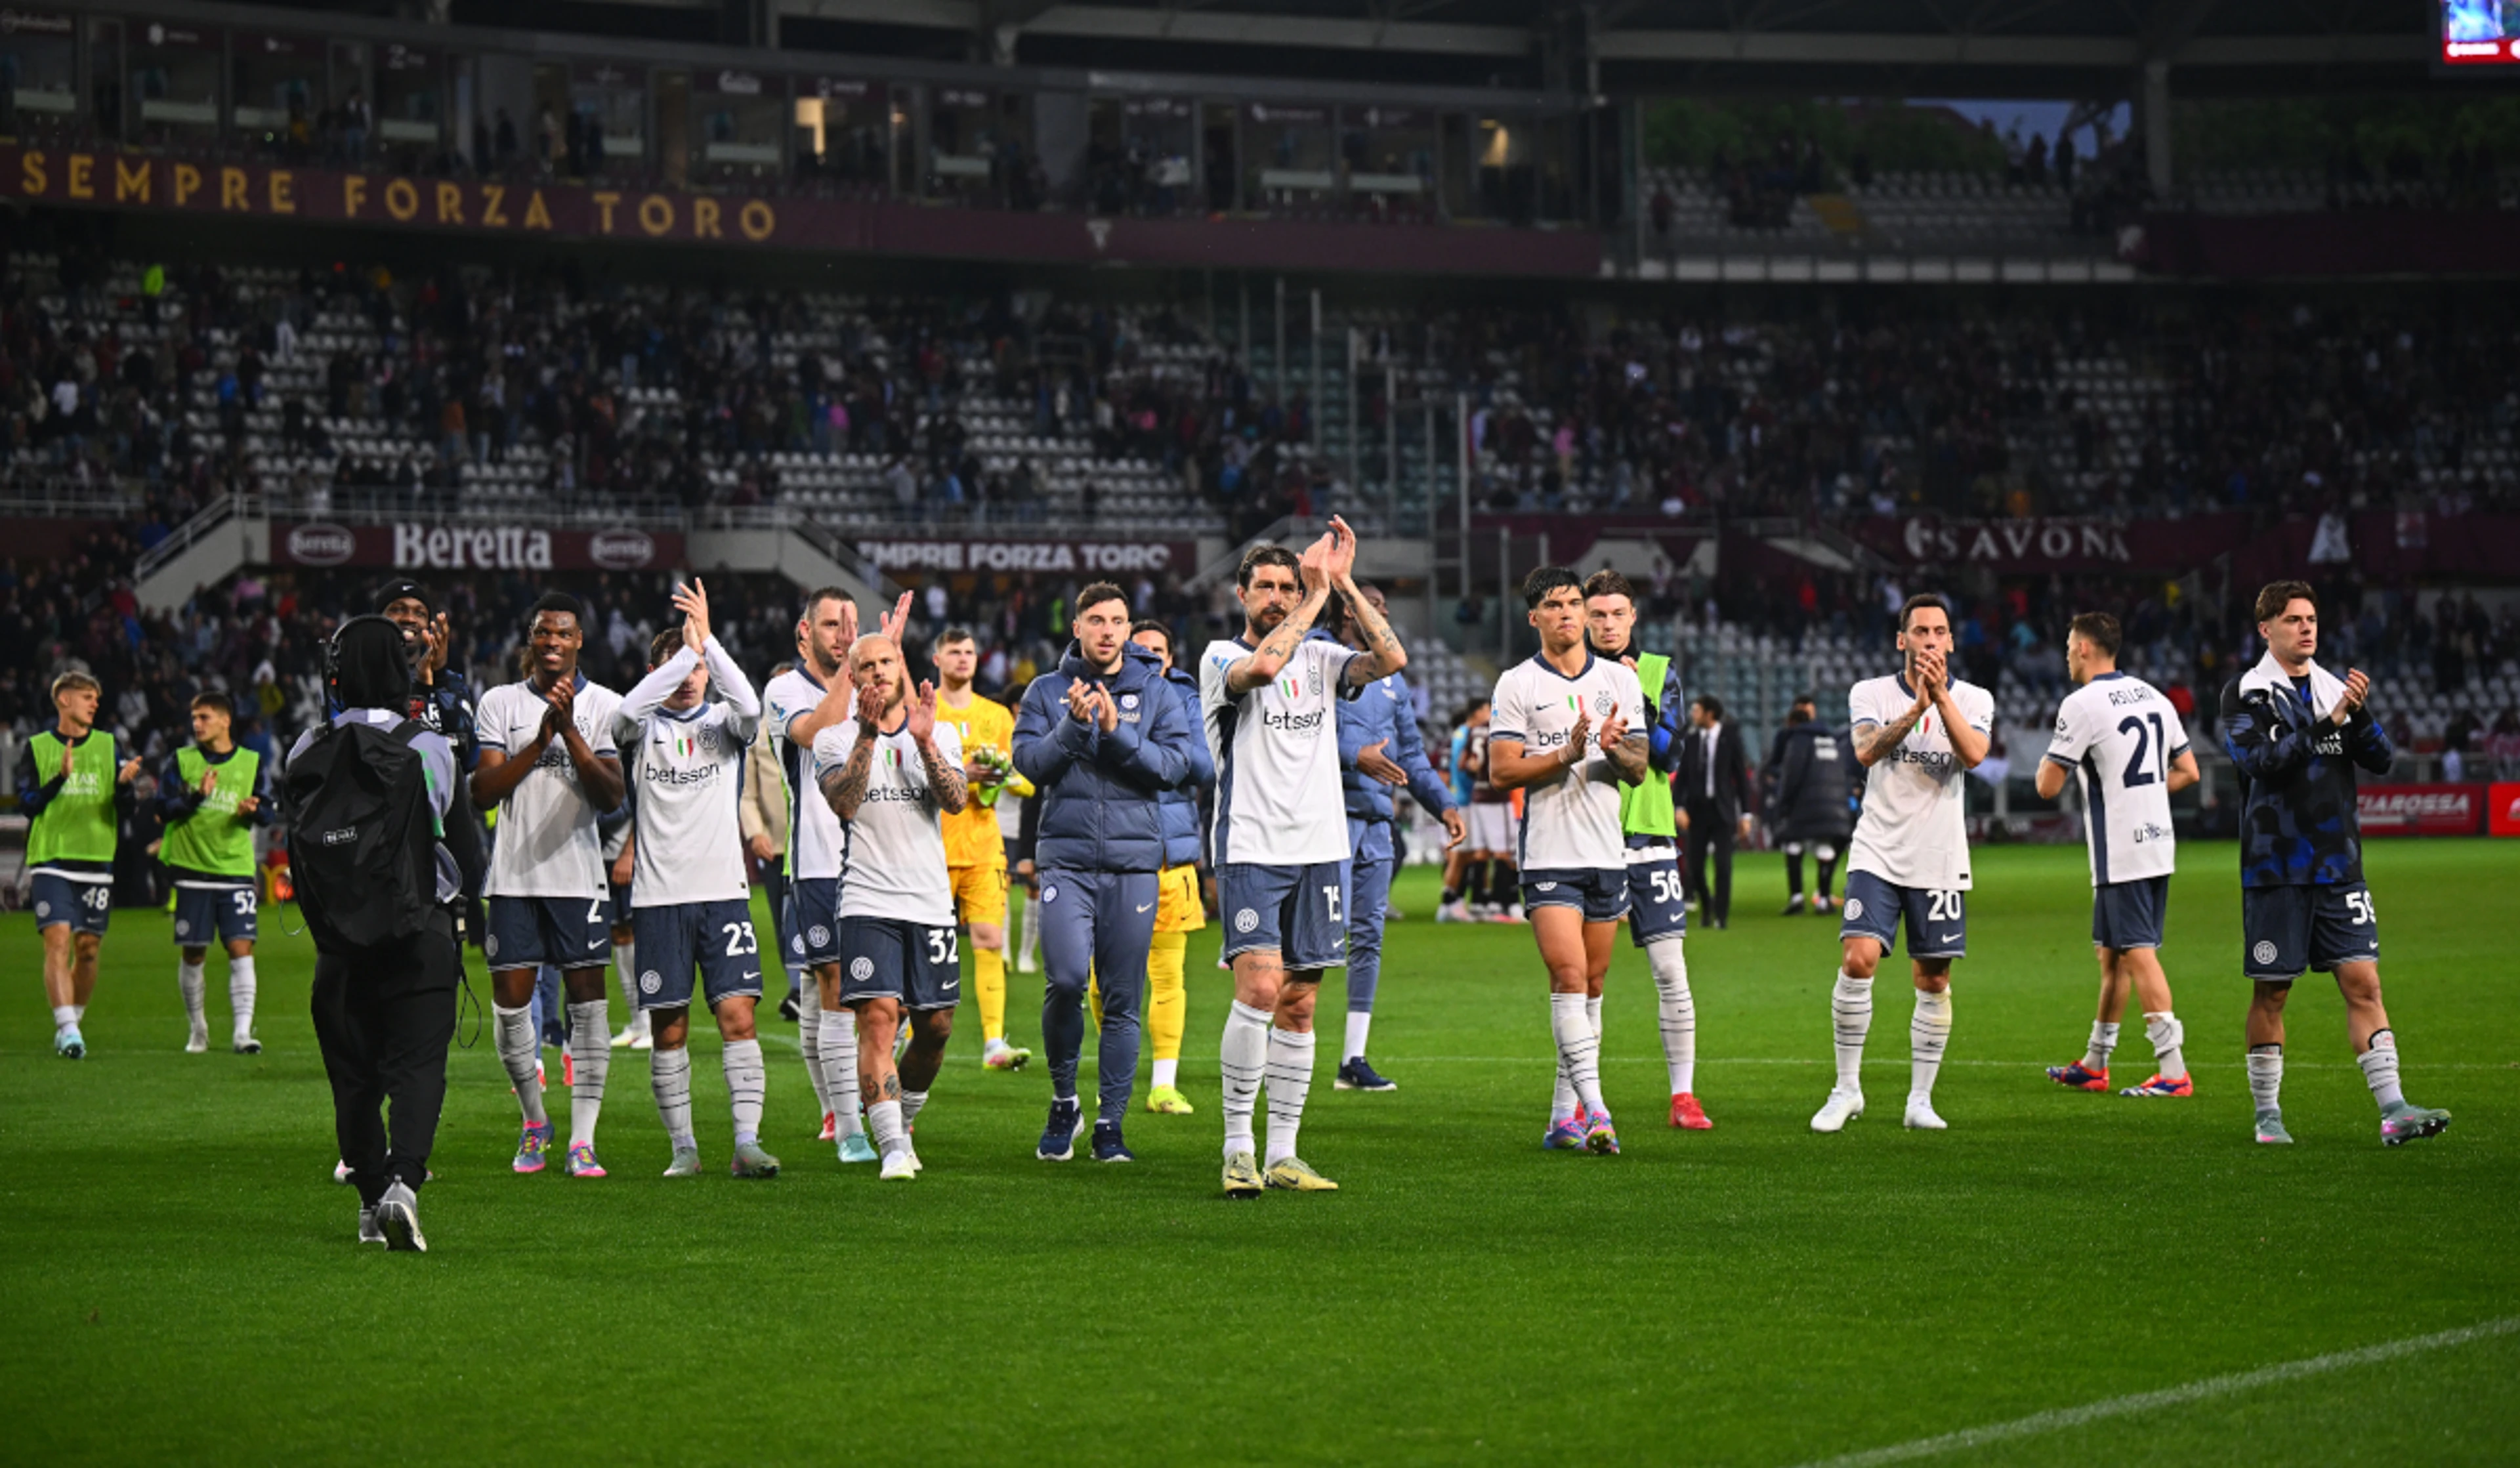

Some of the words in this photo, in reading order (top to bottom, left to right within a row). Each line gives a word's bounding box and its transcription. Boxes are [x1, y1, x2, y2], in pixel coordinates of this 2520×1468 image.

[22, 152, 296, 214] SEMPRE
[345, 175, 553, 230] FORZA
[593, 191, 776, 242] TORO
[393, 522, 553, 568] Beretta
[858, 542, 963, 570] MPRE
[969, 543, 1075, 572] FORZA
[1885, 749, 1952, 765] etsson
[2117, 712, 2165, 788] 21
[645, 762, 721, 784] betsson
[82, 886, 109, 910] 48
[233, 891, 257, 914] 52
[1650, 870, 1683, 904] 56
[1927, 889, 1962, 921] 20
[723, 922, 757, 957] 23
[928, 929, 959, 965] 32
